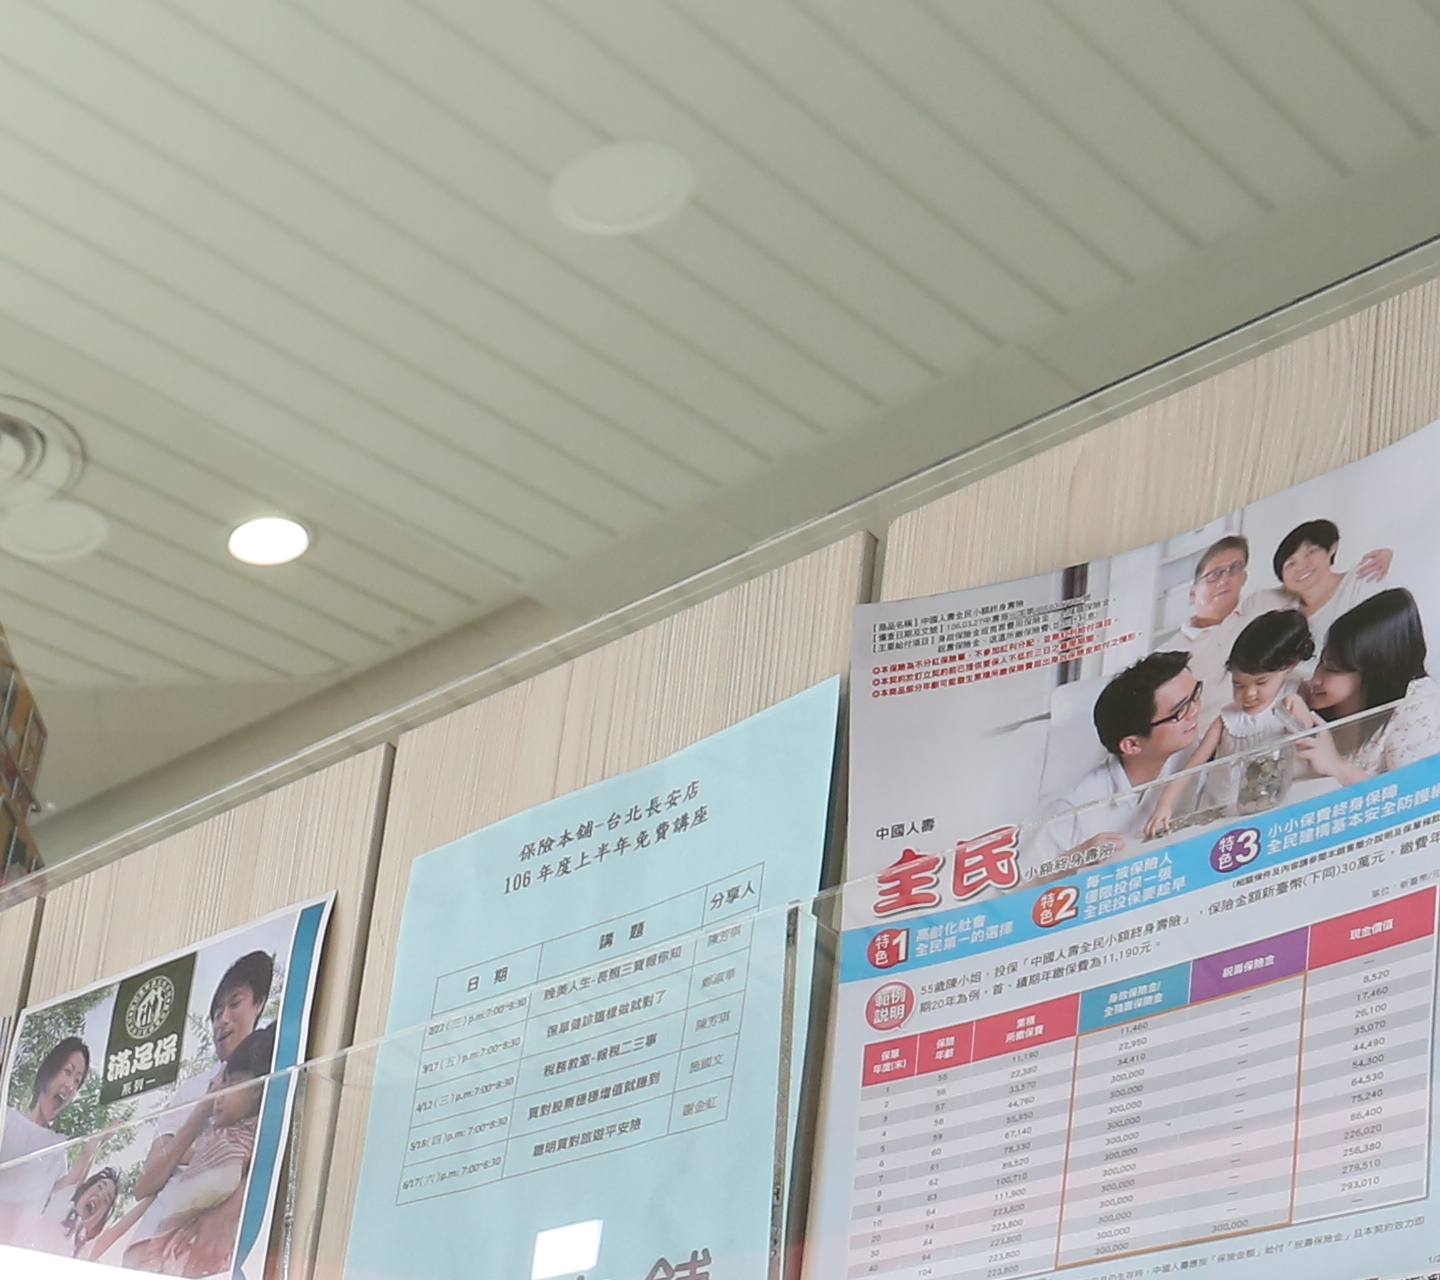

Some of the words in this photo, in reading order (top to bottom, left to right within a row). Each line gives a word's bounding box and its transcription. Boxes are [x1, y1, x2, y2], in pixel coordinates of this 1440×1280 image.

[519, 780, 700, 862] 保險本舖-台北長安店
[875, 818, 935, 840] 中國人壽
[504, 872, 531, 894] 106
[537, 805, 709, 884] 年度上半年免費講座
[1218, 836, 1235, 869] 特色
[1234, 830, 1259, 863] 3
[874, 824, 1019, 917] 全民
[710, 880, 755, 911] 分享人
[1040, 893, 1055, 925] 特色
[1054, 887, 1078, 920] 2
[1349, 918, 1394, 941] 現金價值
[876, 934, 892, 967] 特色
[892, 928, 909, 962] 1
[1362, 968, 1390, 984] 8,520
[1356, 986, 1389, 1001] 17,460
[874, 1005, 905, 1023] 說明
[1353, 1037, 1385, 1052] 44,490
[107, 1032, 178, 1083] 滿足保
[1351, 1088, 1383, 1104] 75,240
[1343, 1124, 1382, 1141] 226,020
[1340, 1176, 1380, 1192] 293,010
[1211, 1219, 1248, 1234] 300,000
